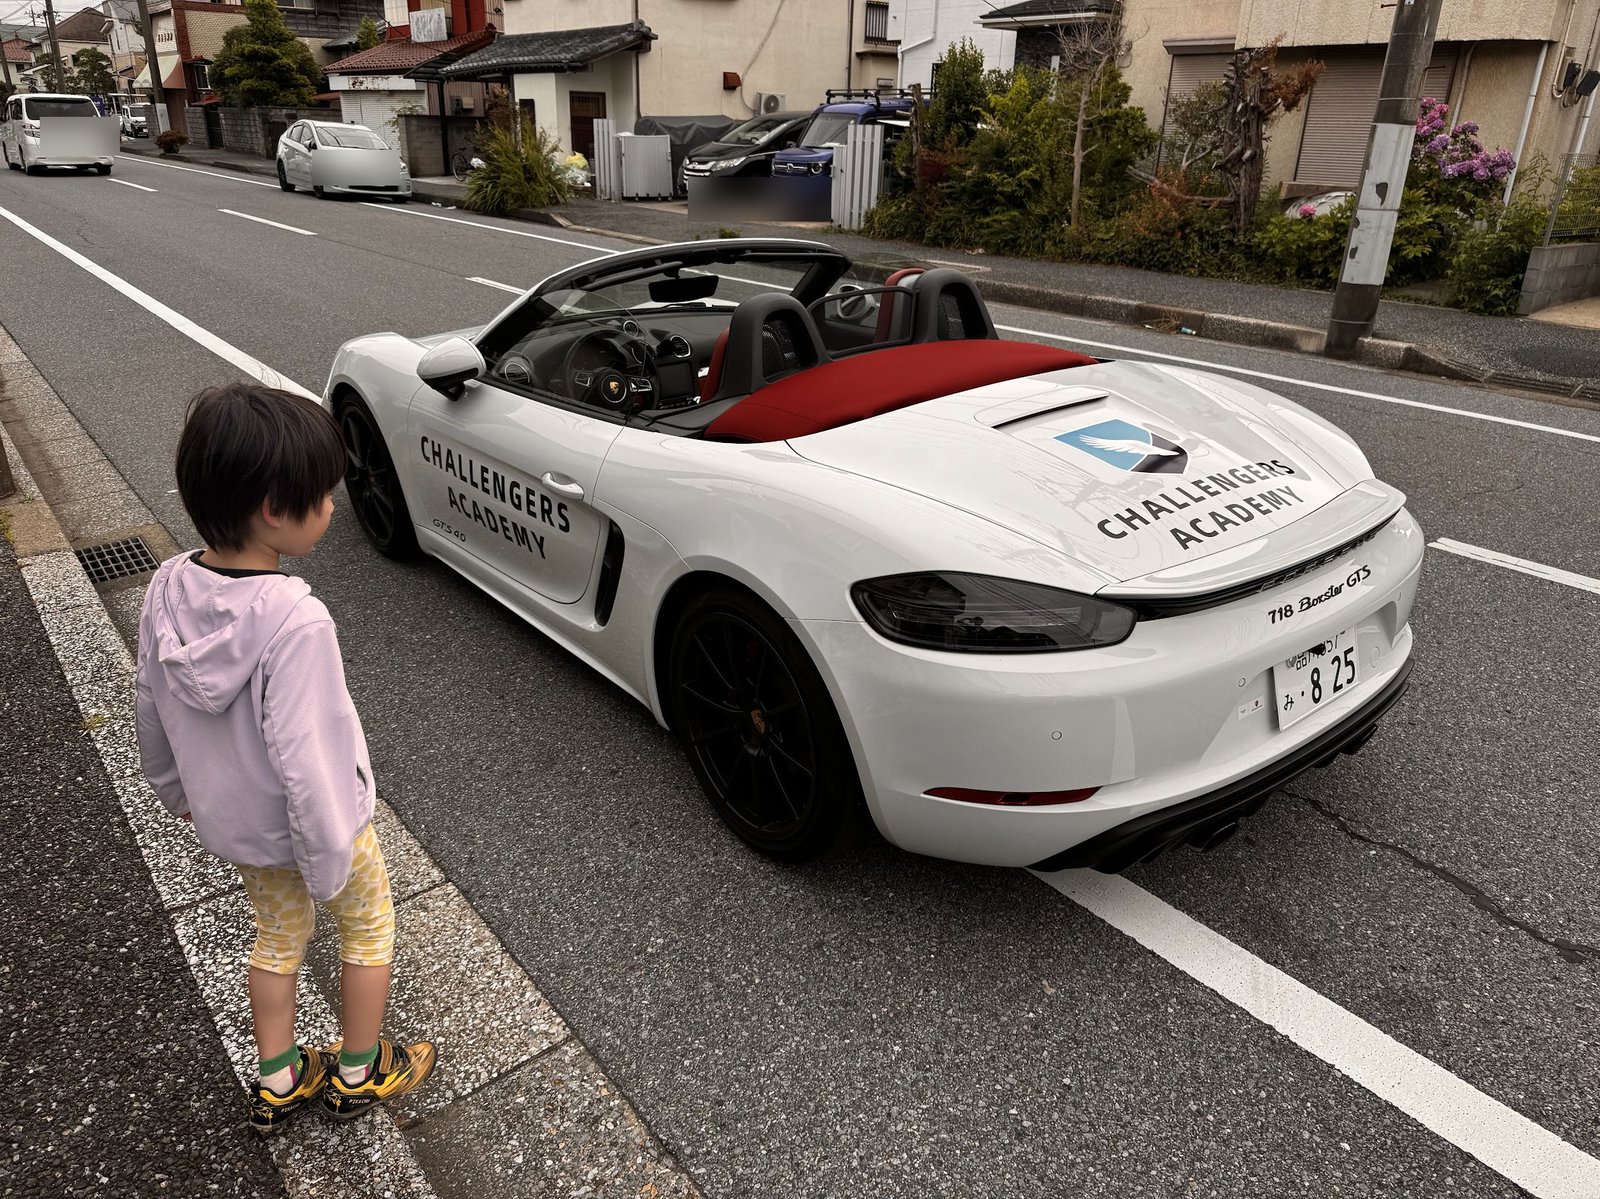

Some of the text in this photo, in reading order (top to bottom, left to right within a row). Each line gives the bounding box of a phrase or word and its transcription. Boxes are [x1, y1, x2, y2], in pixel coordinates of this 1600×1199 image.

[420, 435, 571, 533] CHALLENGERS
[1096, 459, 1296, 540] CHALLENGERS
[1168, 485, 1305, 551] ACADEMY
[432, 518, 453, 534] GTS
[447, 485, 546, 560] ACADEMY
[1267, 564, 1372, 625] 718 Boxster GTS
